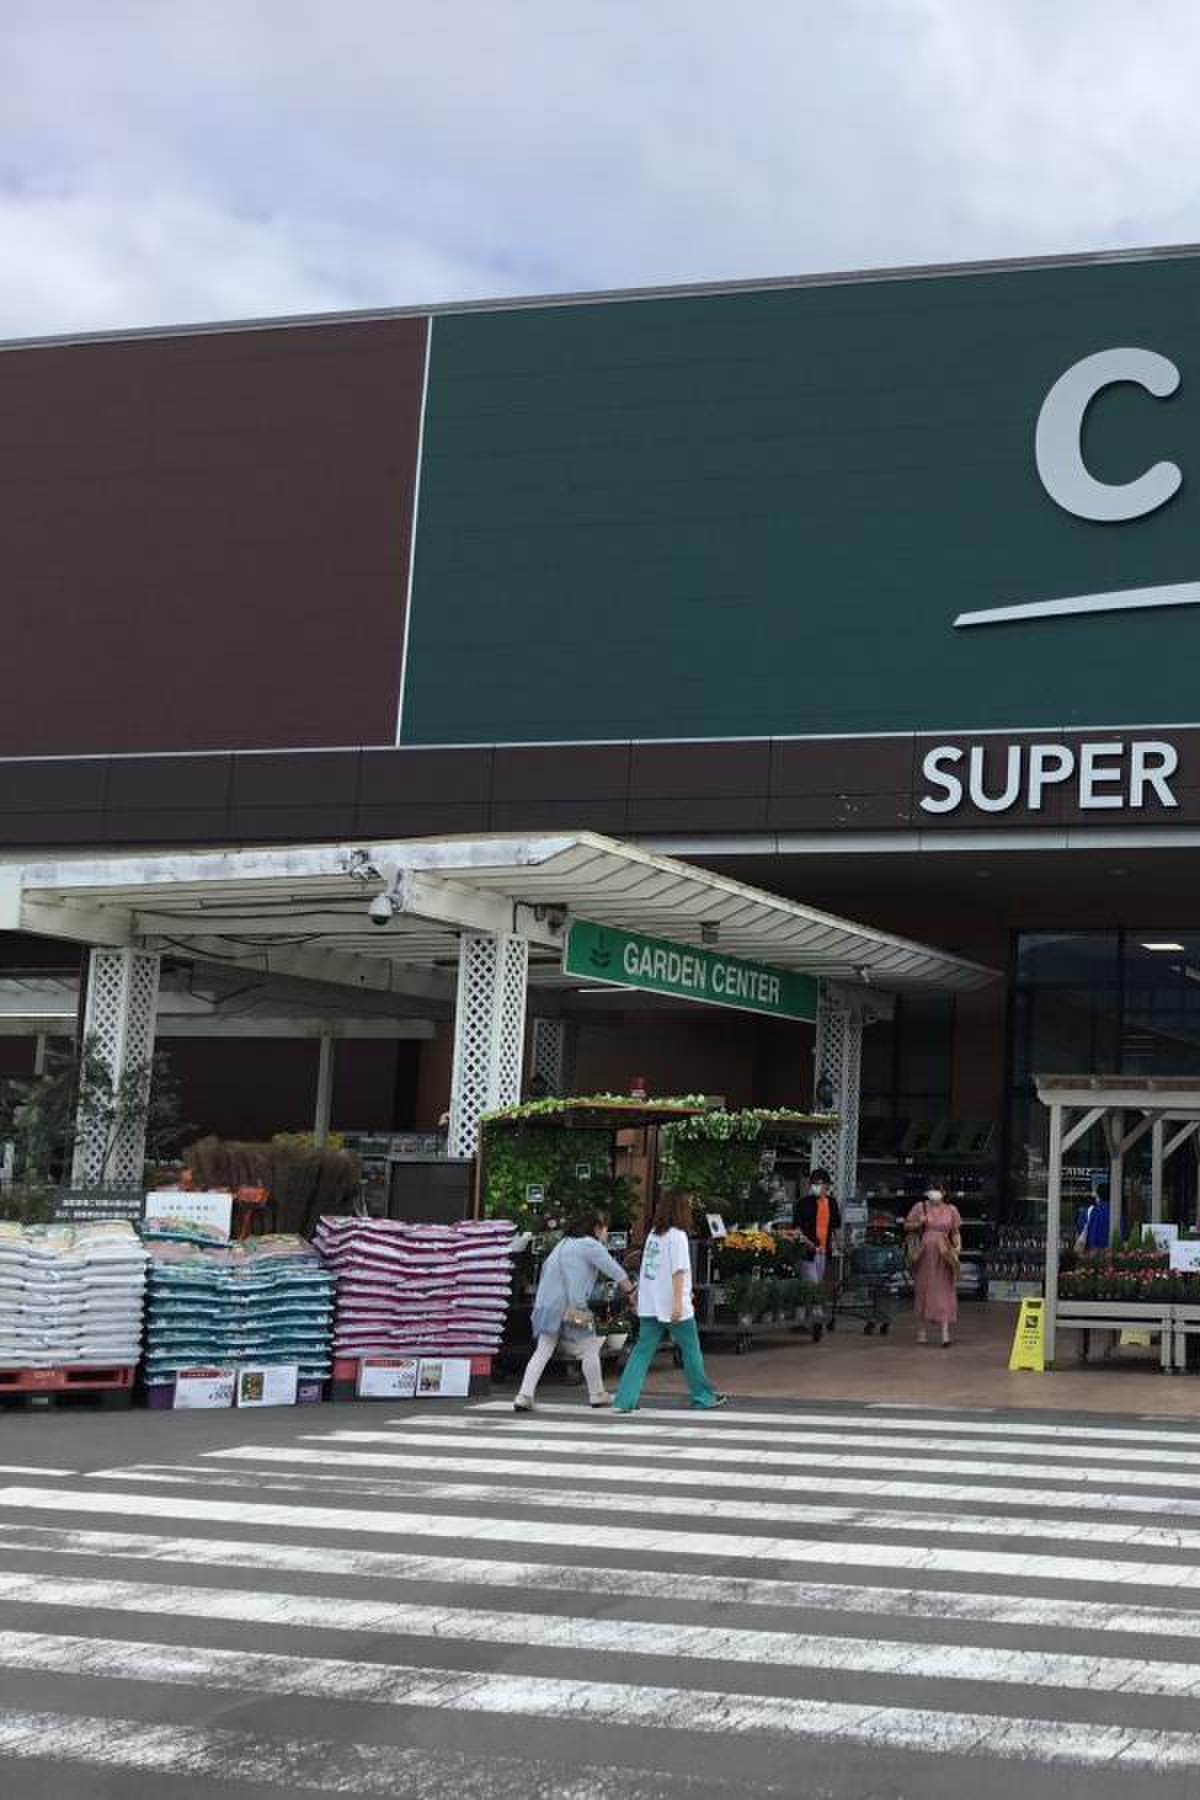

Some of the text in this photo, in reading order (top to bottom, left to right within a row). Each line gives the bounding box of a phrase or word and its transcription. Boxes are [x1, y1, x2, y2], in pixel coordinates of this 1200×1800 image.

[919, 740, 1179, 815] SUPER
[623, 941, 780, 1005] GARDEN CENTER
